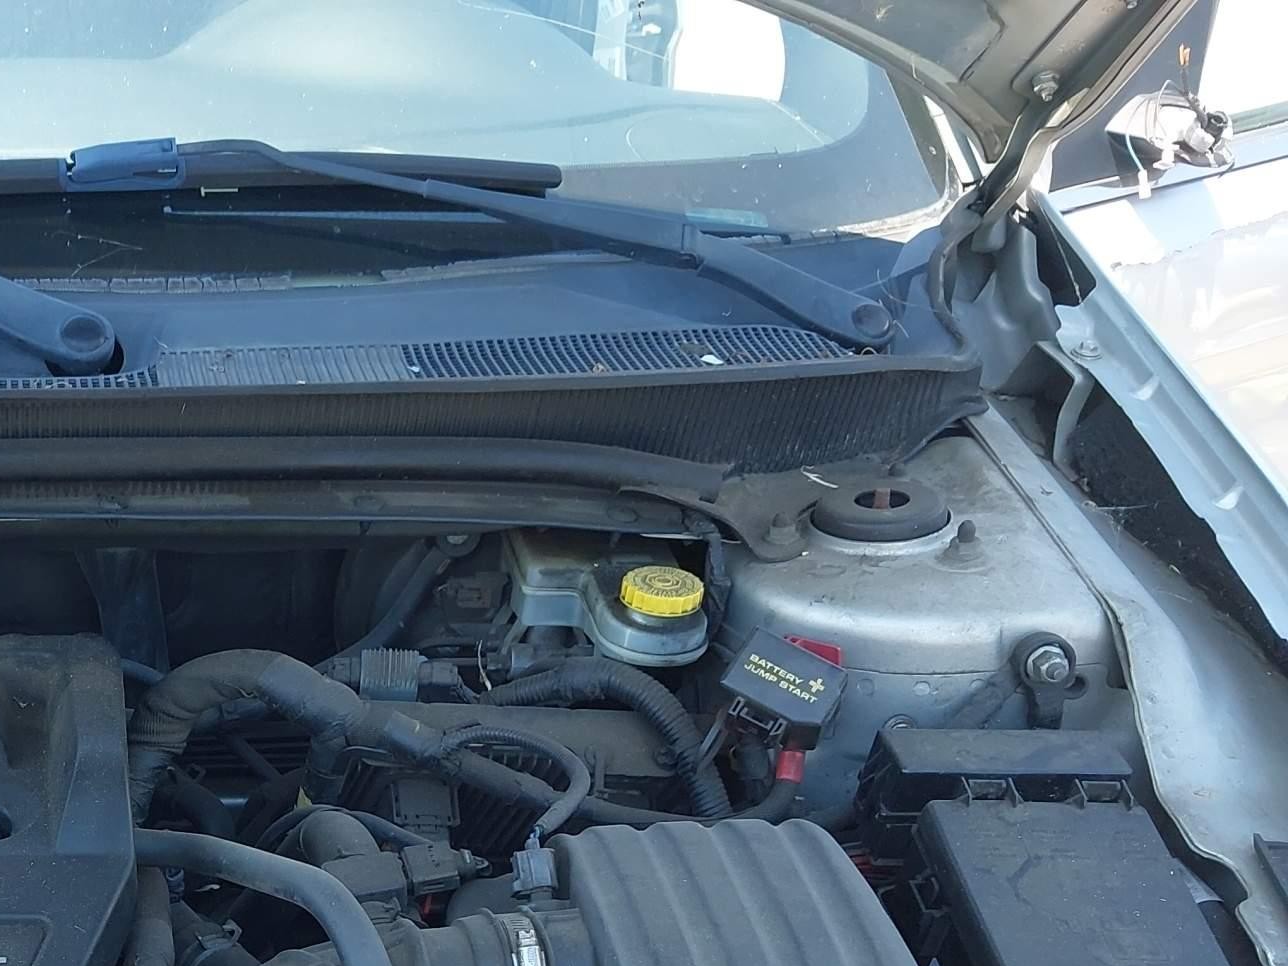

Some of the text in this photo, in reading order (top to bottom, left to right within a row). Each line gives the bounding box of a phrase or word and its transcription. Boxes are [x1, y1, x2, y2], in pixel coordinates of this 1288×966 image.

[743, 663, 818, 704] JUMP START
[749, 653, 804, 686] BATTERY
